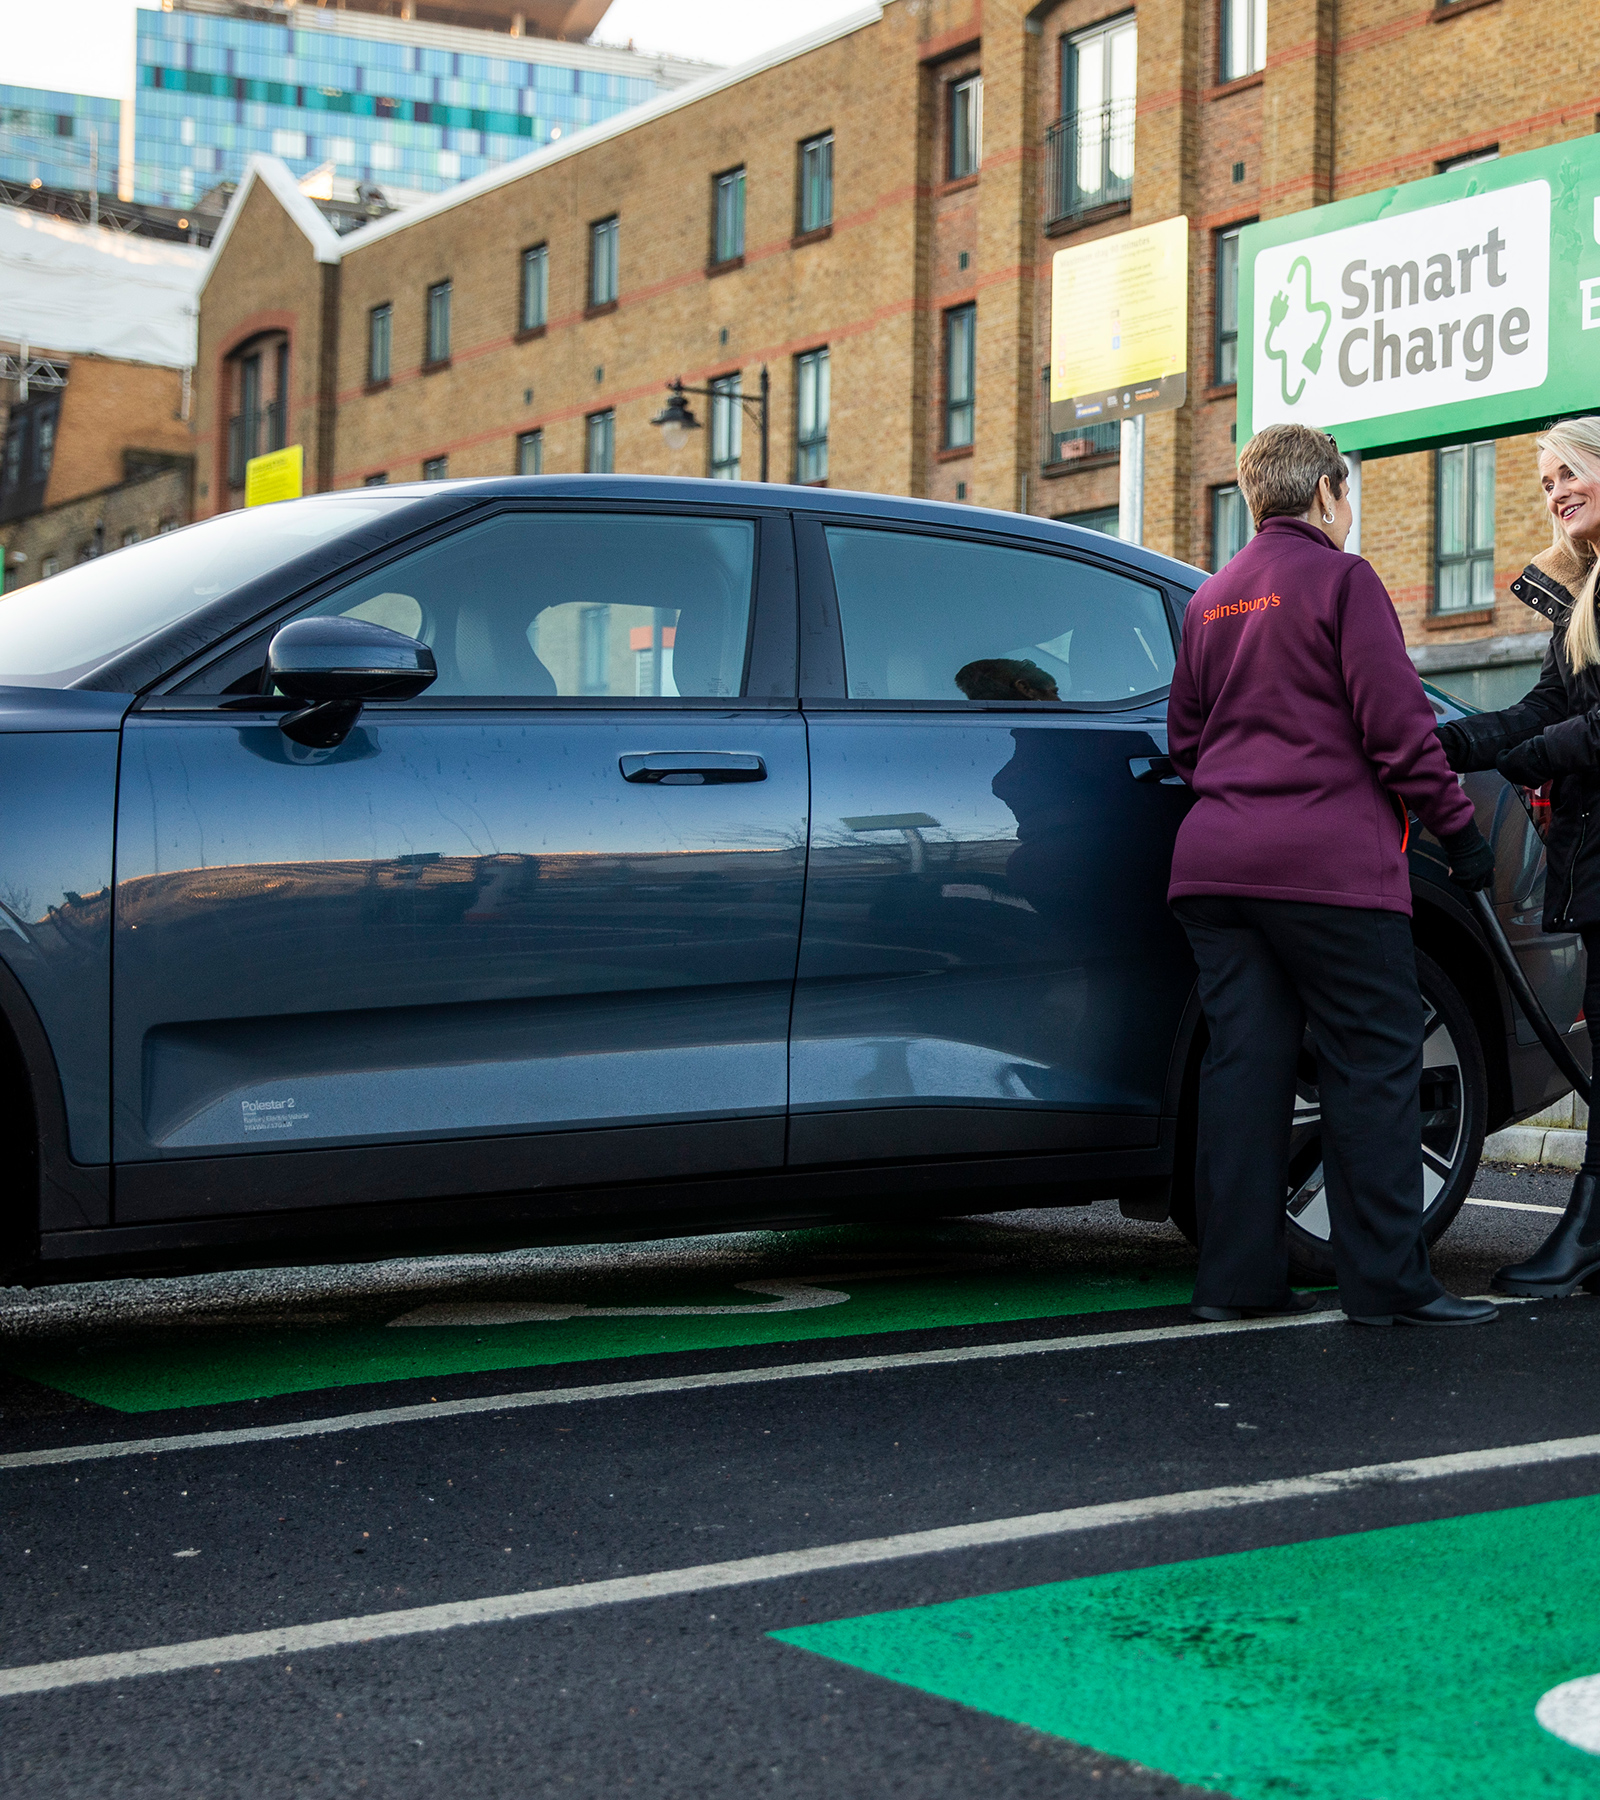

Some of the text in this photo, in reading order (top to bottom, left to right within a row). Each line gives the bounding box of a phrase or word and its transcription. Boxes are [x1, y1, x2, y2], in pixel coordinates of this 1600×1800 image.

[1340, 227, 1508, 320] Smart
[1338, 307, 1531, 388] Charge
[1203, 593, 1281, 625] Sainsbury's
[241, 1098, 295, 1111] Polestar 2
